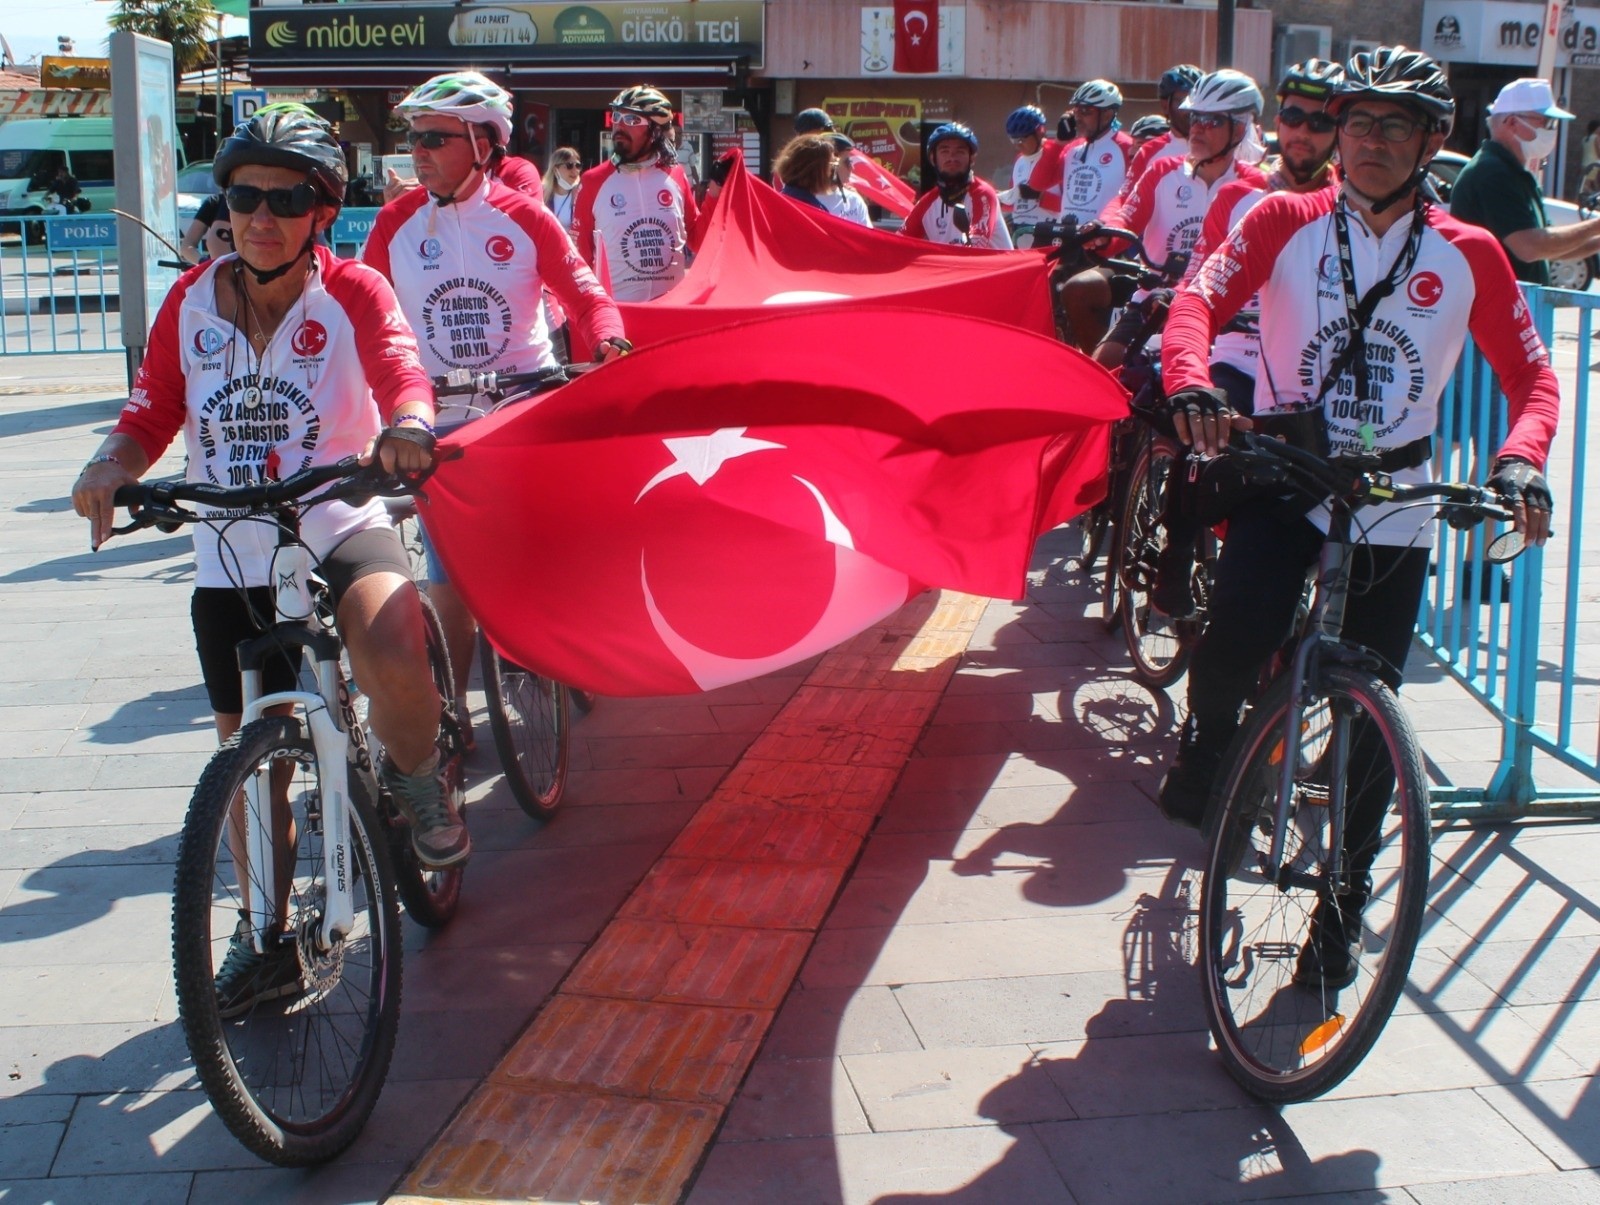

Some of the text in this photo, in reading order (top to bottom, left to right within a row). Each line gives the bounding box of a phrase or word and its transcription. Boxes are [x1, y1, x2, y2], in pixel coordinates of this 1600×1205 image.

[474, 15, 510, 24] ALO PAKET
[391, 15, 425, 47] evi
[482, 28, 499, 43] 797
[502, 28, 514, 43] 71
[518, 27, 531, 43] 44
[562, 34, 605, 43] ADIYAMAN
[243, 100, 257, 118] D
[64, 225, 109, 238] POLİS
[425, 277, 465, 306] TAARRUZ
[468, 277, 507, 307] BİSİKLET
[500, 306, 512, 333] TURU
[440, 295, 489, 312] 22 AĞUSTOS
[441, 312, 490, 327] 26 AĞUSTOS
[450, 326, 486, 342] 09 EYLÜL
[450, 342, 491, 359] 100.YIL
[1297, 342, 1322, 386] BÜYÜK
[1376, 318, 1421, 365] BİSİKLET
[1407, 366, 1425, 403] TURU
[1336, 378, 1352, 396] 09
[218, 403, 233, 422] 22
[262, 376, 315, 416] BİSİKLET
[305, 414, 320, 451] TURU
[221, 422, 290, 443] 26 AĞUSTOS
[229, 444, 244, 462] 09
[336, 843, 346, 879] SUNTOUR
